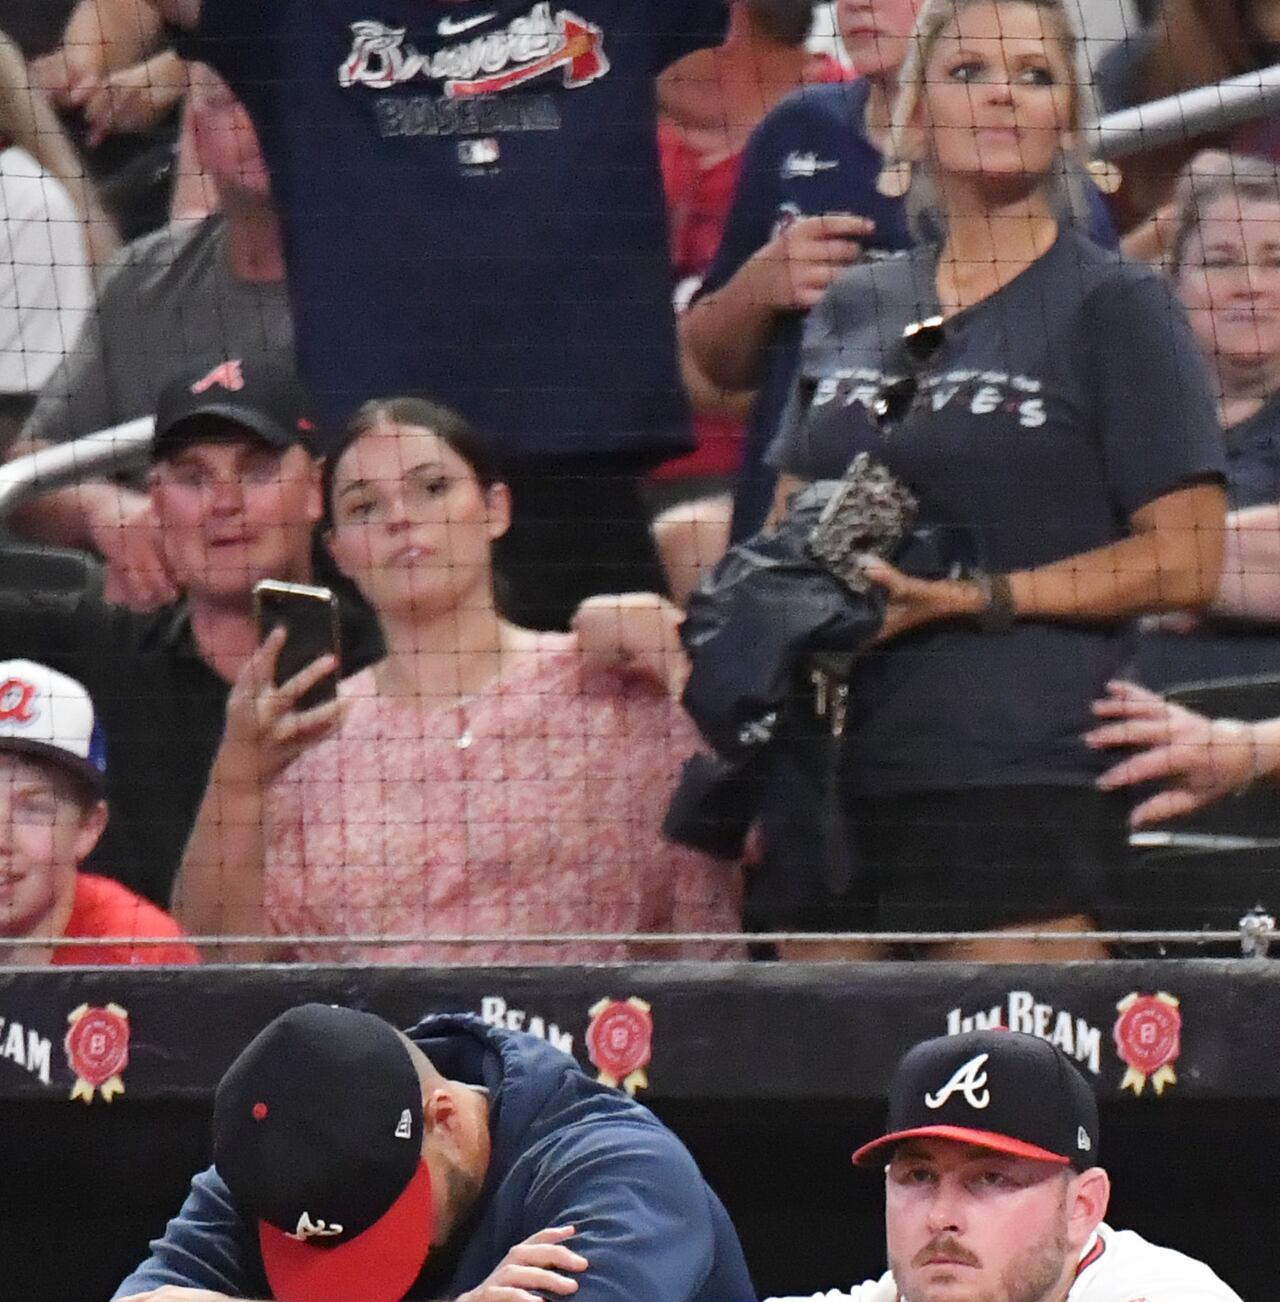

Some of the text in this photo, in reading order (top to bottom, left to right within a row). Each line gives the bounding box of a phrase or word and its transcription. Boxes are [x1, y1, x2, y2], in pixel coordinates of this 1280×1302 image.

[812, 370, 1047, 428] BRVES
[1008, 991, 1102, 1074] BEAM
[925, 1053, 990, 1109] A
